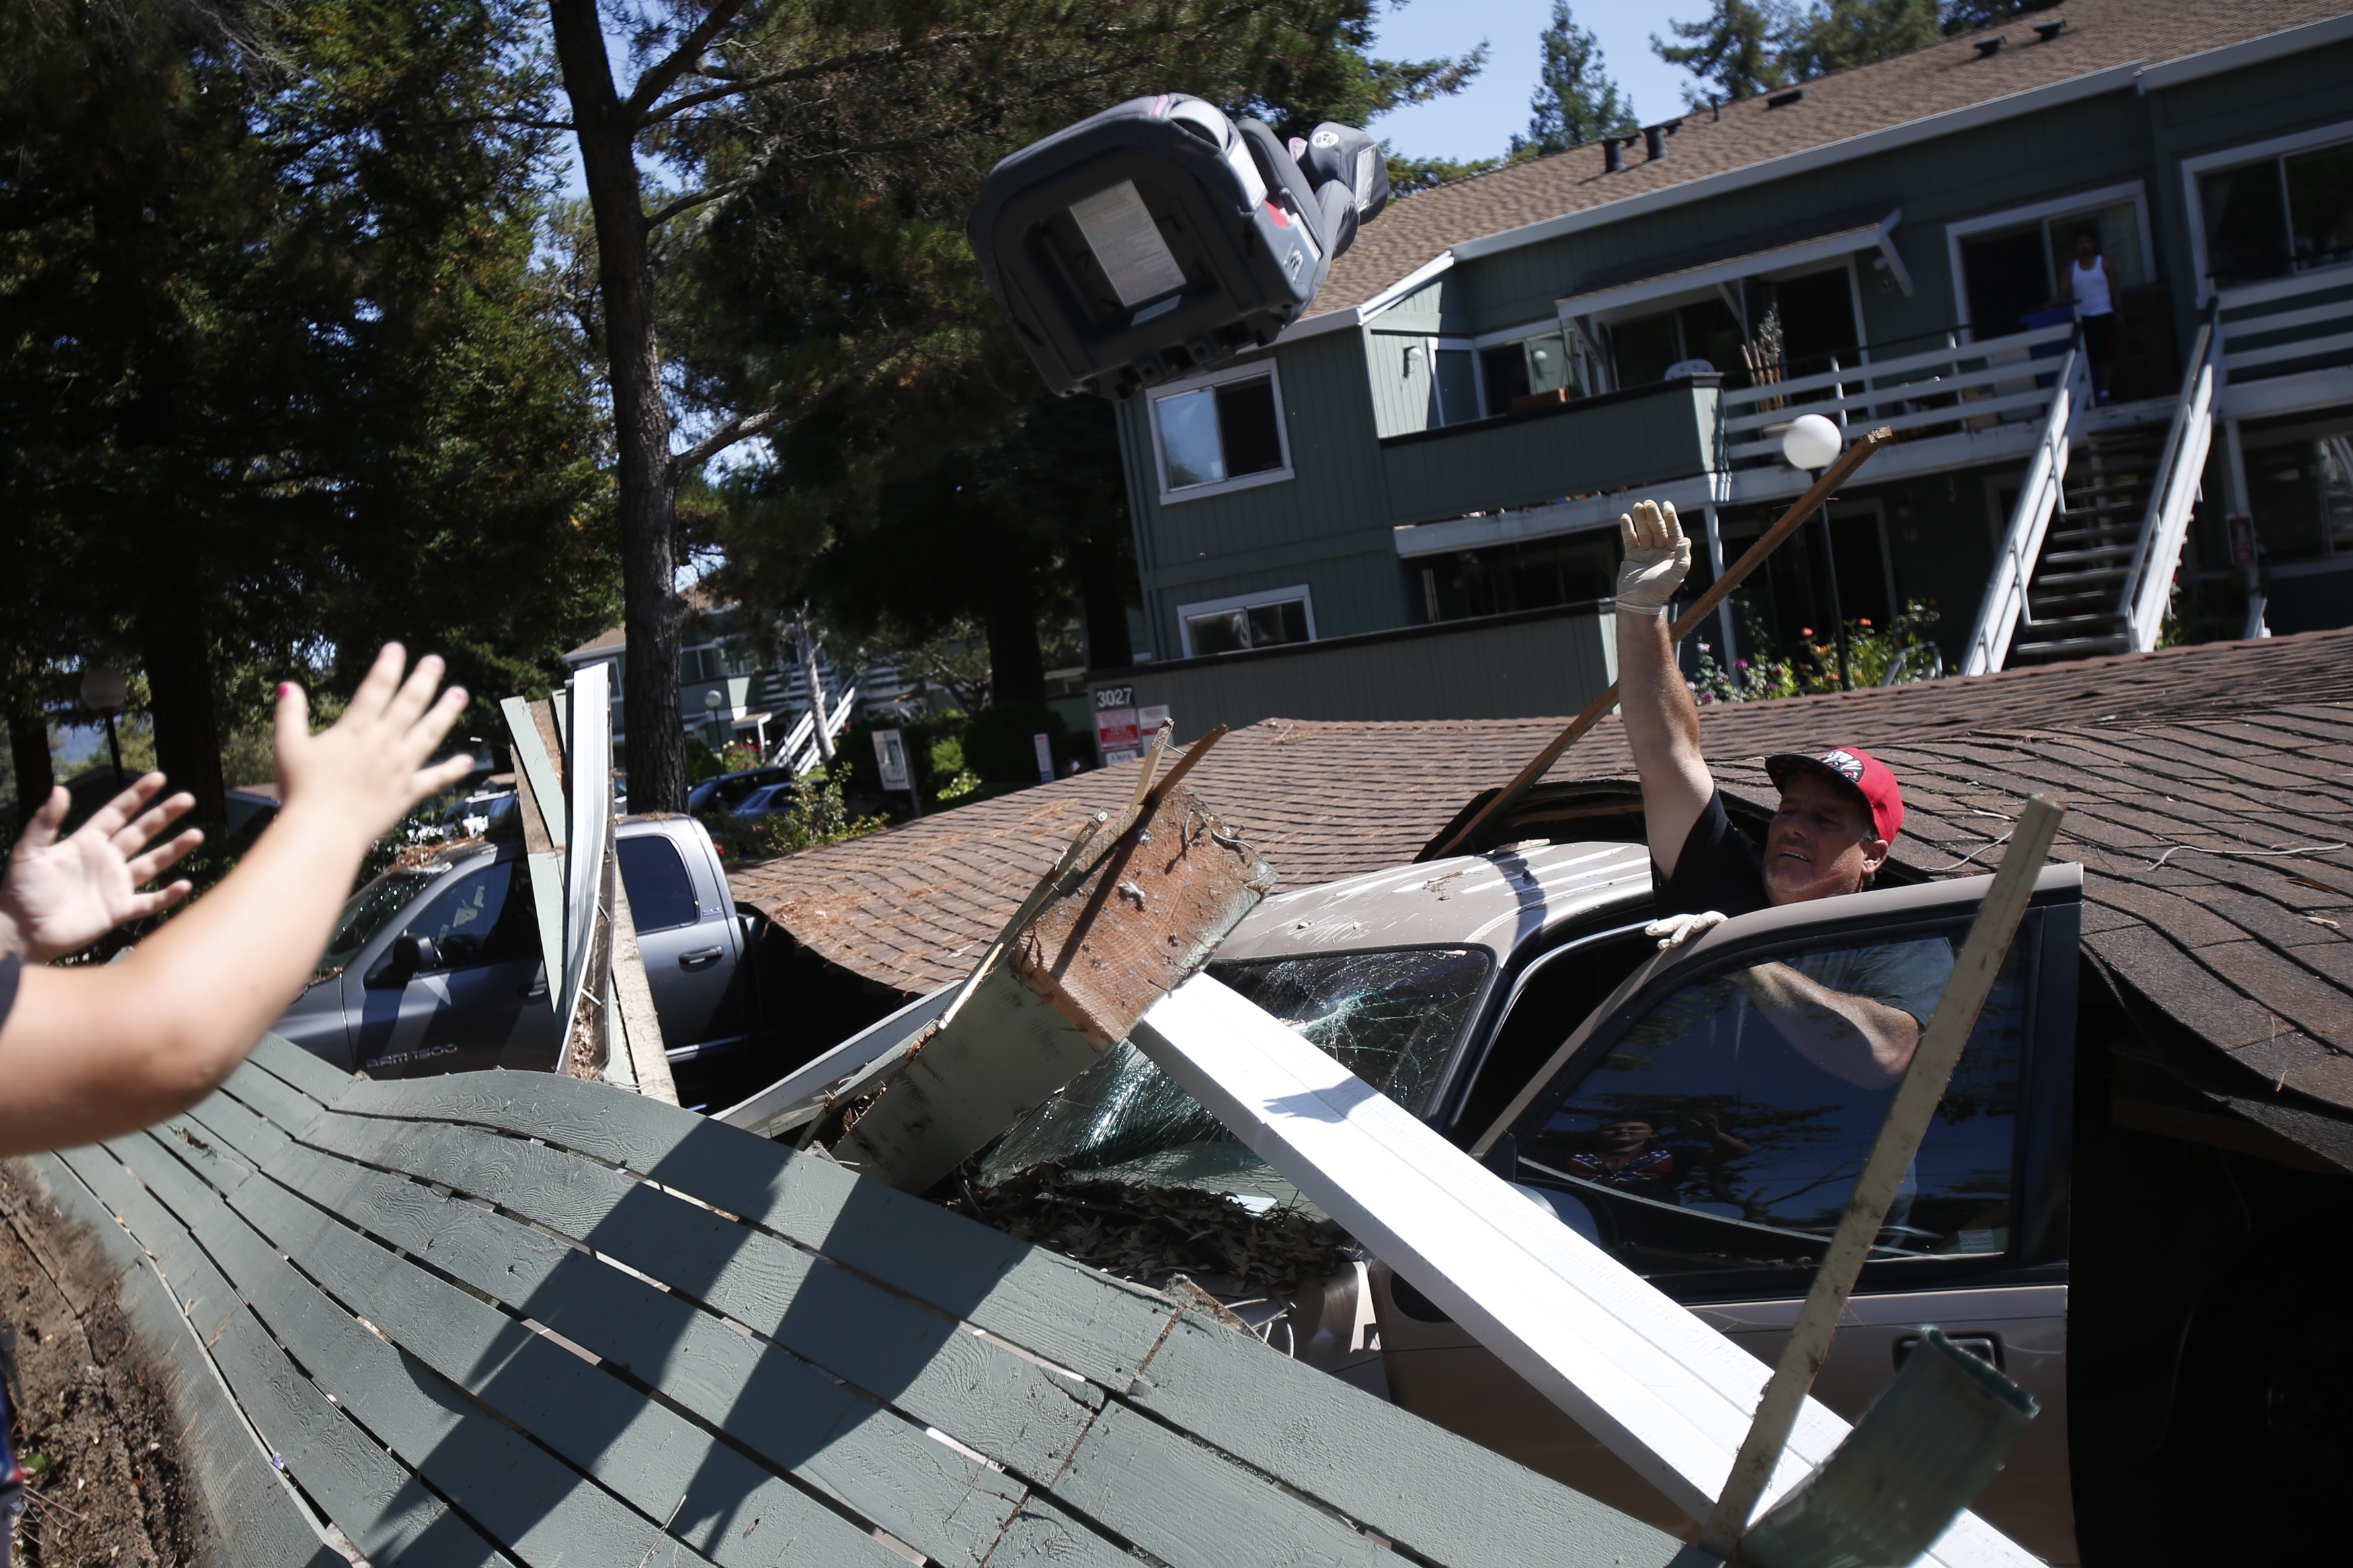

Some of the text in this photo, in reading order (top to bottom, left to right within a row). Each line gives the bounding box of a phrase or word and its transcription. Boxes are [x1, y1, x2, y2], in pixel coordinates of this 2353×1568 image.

[1097, 688, 1132, 708] 3027
[366, 1043, 458, 1069] RAM 1500
